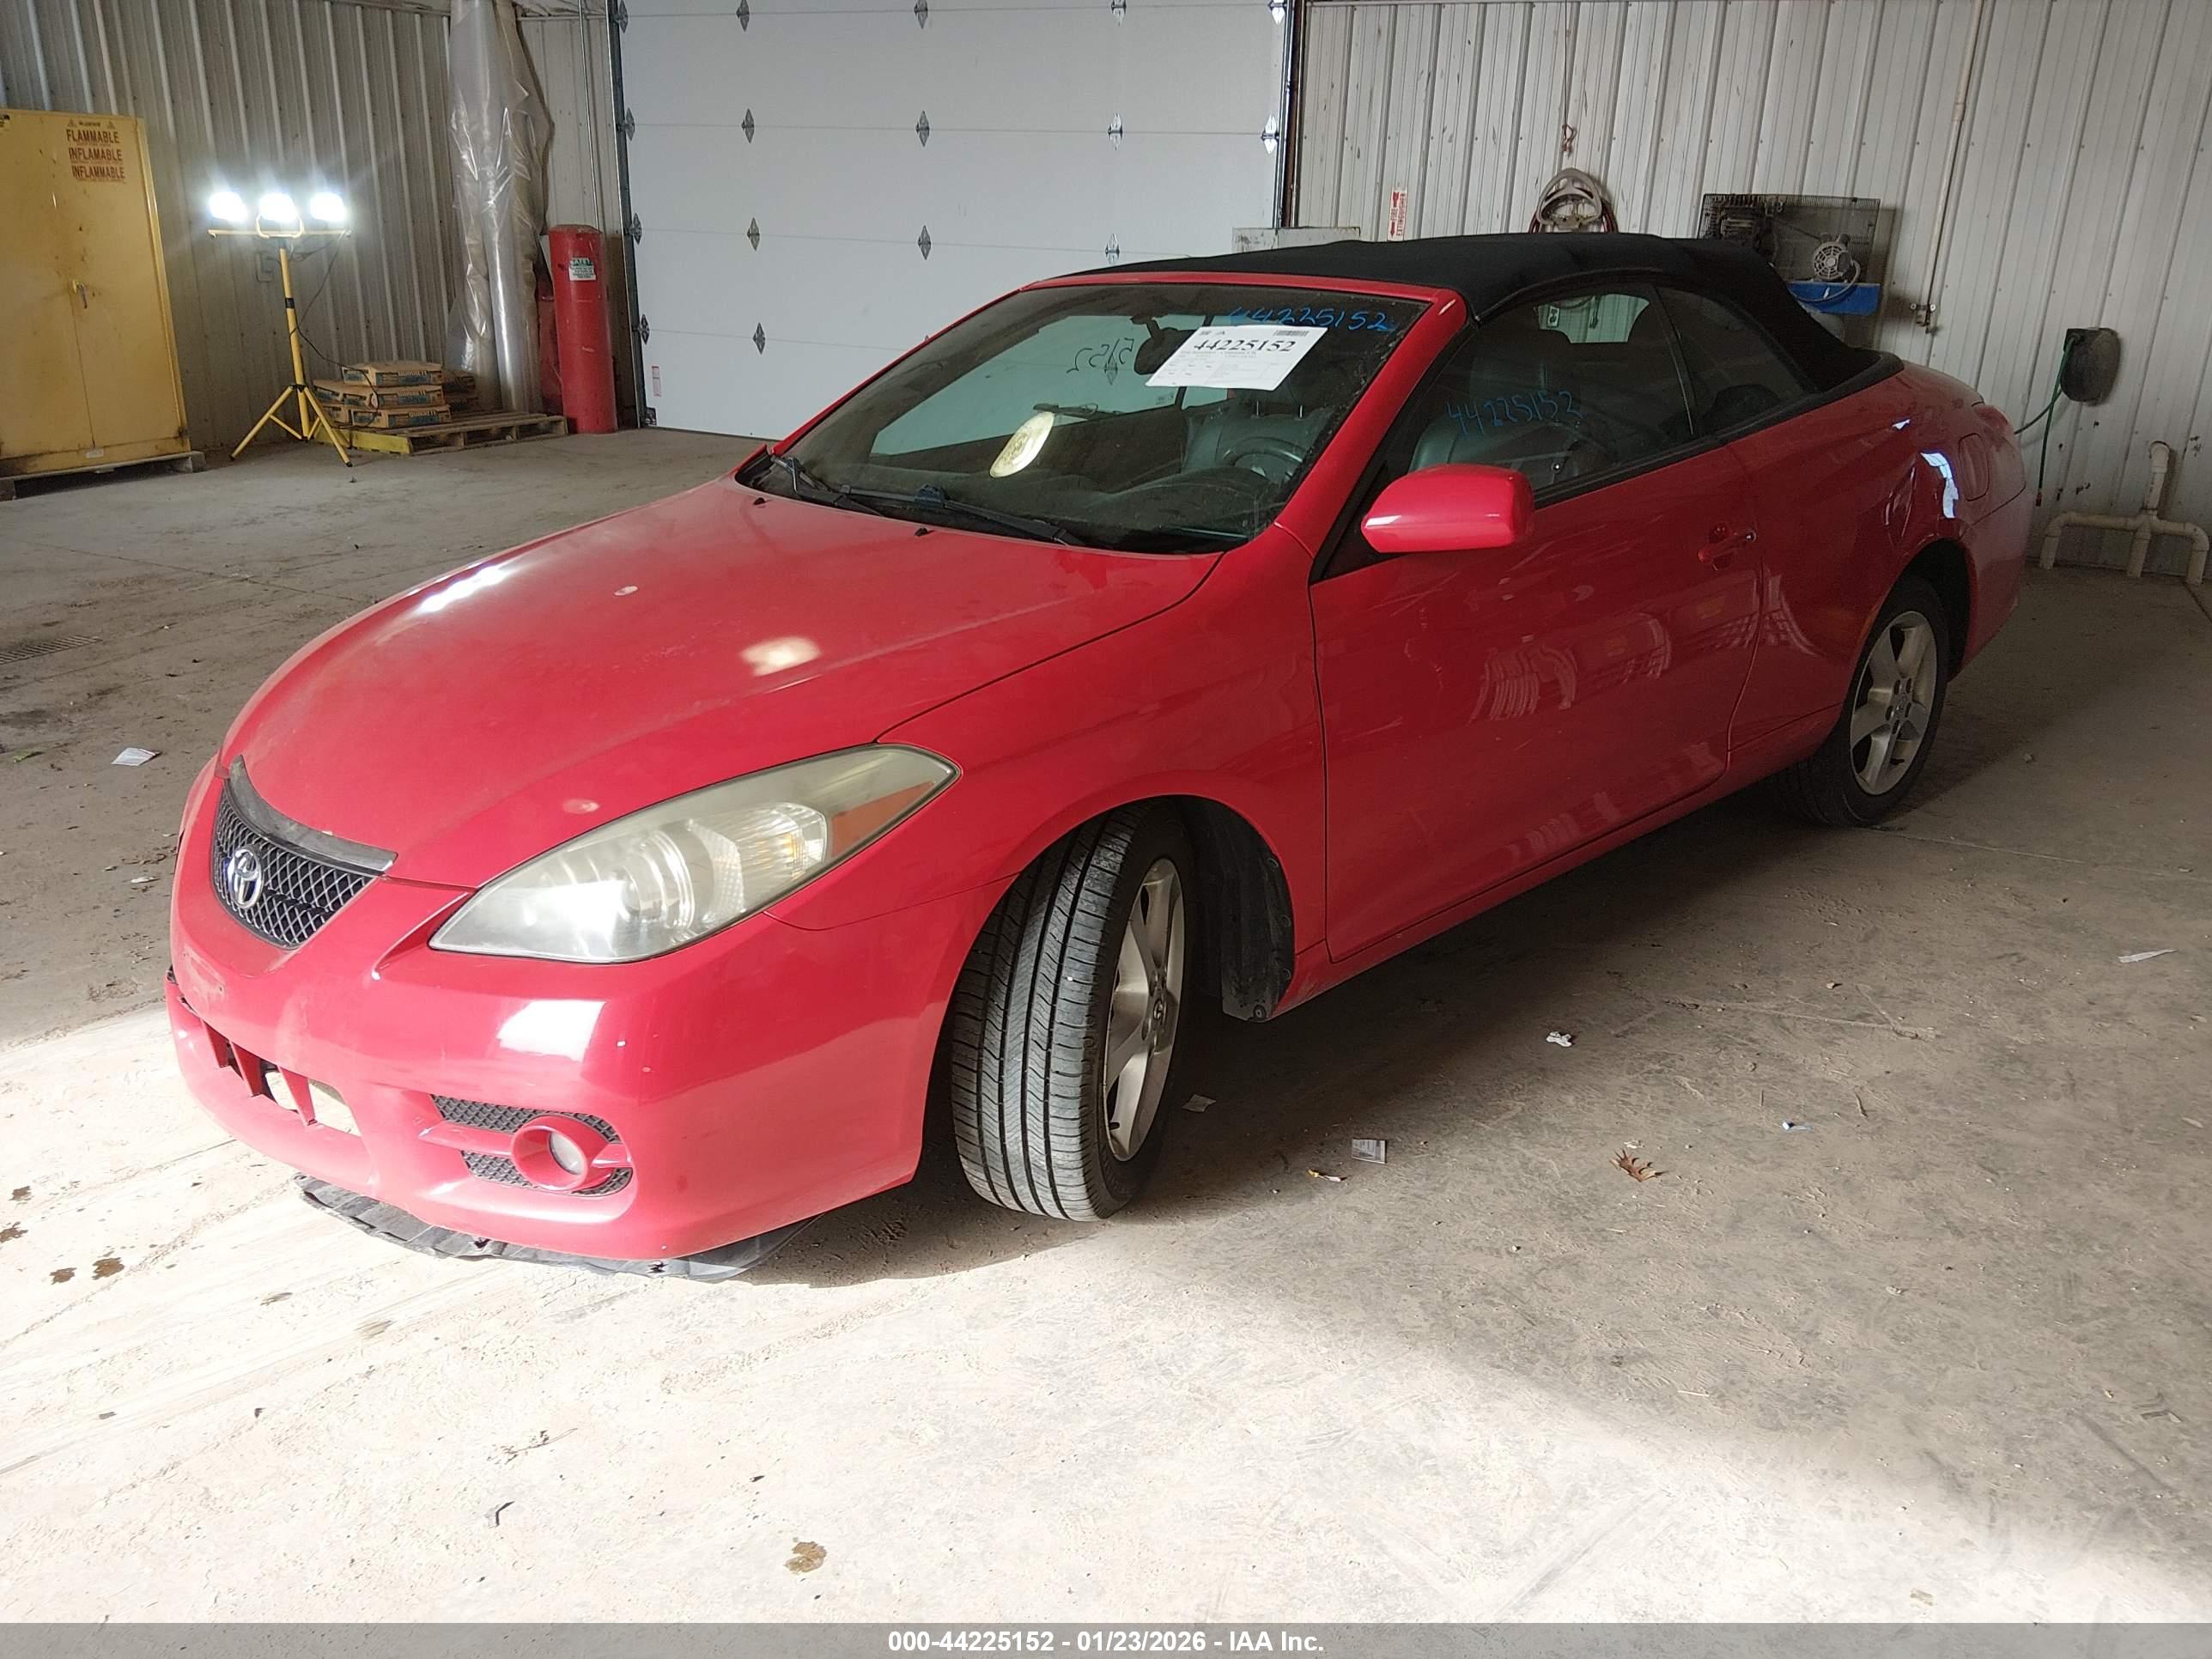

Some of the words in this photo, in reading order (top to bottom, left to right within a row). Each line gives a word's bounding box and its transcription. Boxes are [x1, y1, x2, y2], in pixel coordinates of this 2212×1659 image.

[66, 129, 120, 144] FLAMMABLE
[69, 147, 123, 161] INFLAMABLE
[71, 165, 125, 179] INFLAMMABLE
[1194, 339, 1297, 352] 44225152
[1446, 389, 1583, 436] 44225152
